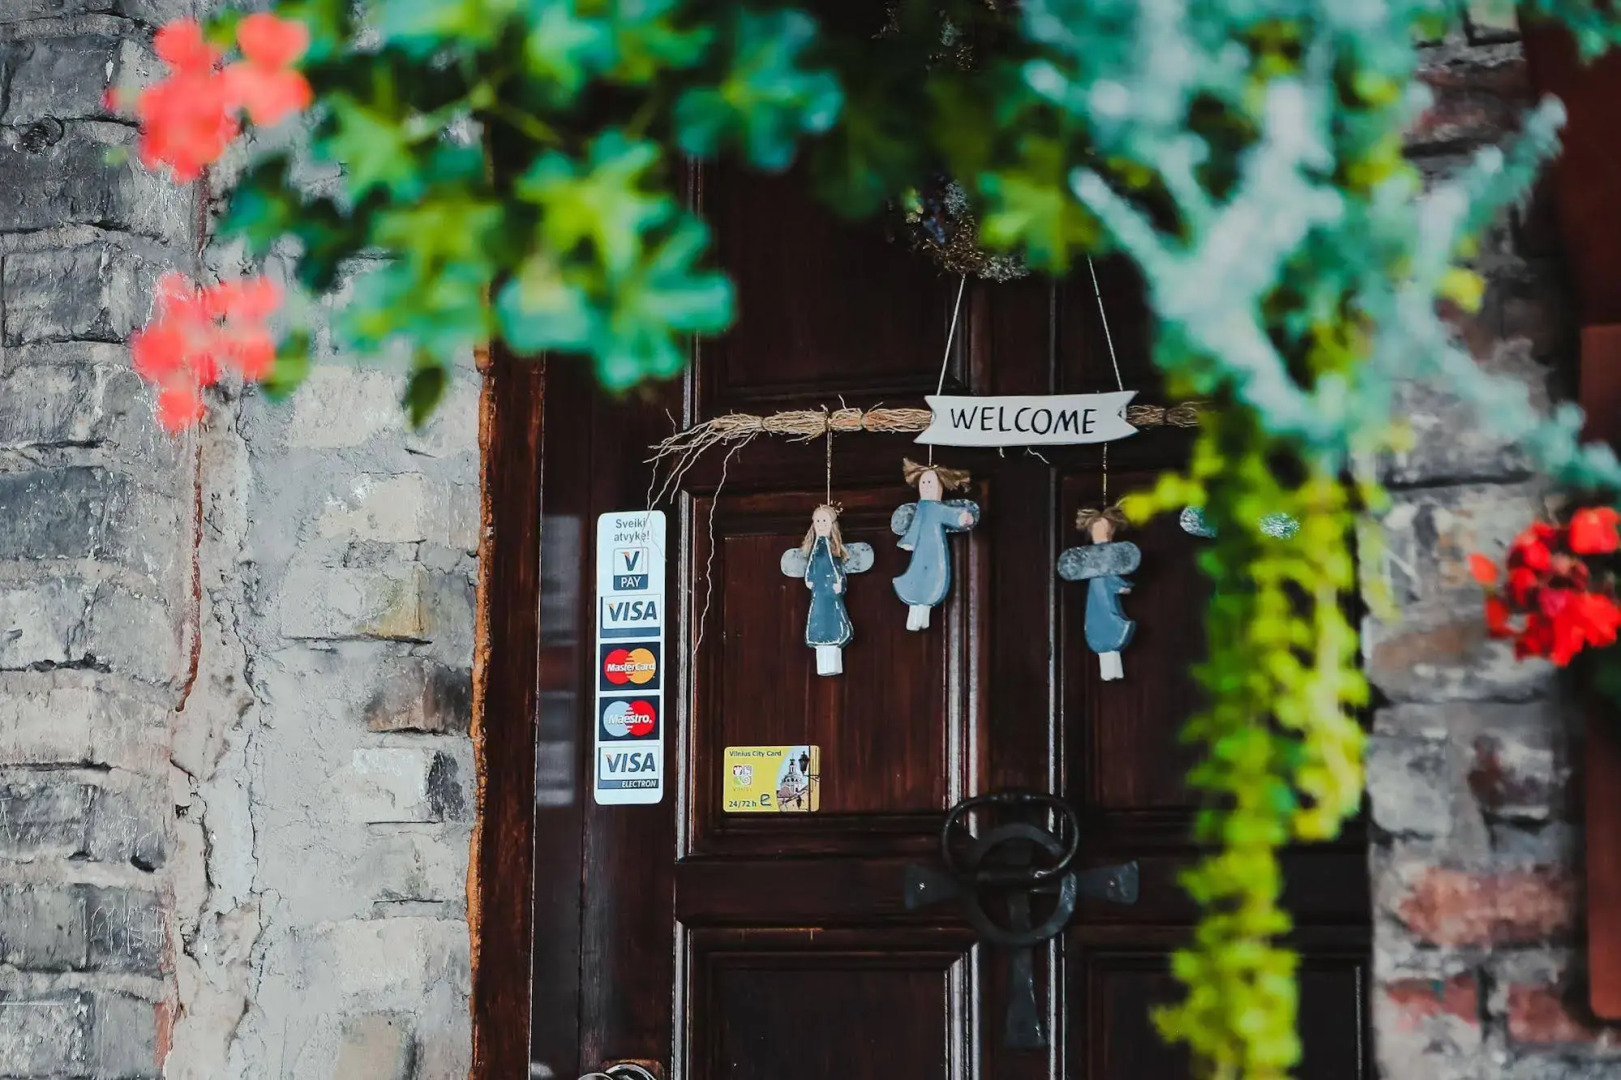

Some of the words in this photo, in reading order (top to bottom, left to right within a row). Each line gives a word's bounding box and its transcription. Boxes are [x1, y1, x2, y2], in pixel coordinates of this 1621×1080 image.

[951, 406, 1097, 435] WELCOME
[615, 518, 646, 529] Sveiki
[622, 551, 640, 571] V
[621, 576, 641, 588] PAY
[609, 601, 657, 622] VISA
[607, 662, 656, 672] MasterCard
[752, 750, 765, 758] City
[605, 752, 656, 773] VISA
[621, 779, 657, 788] ELECTRON
